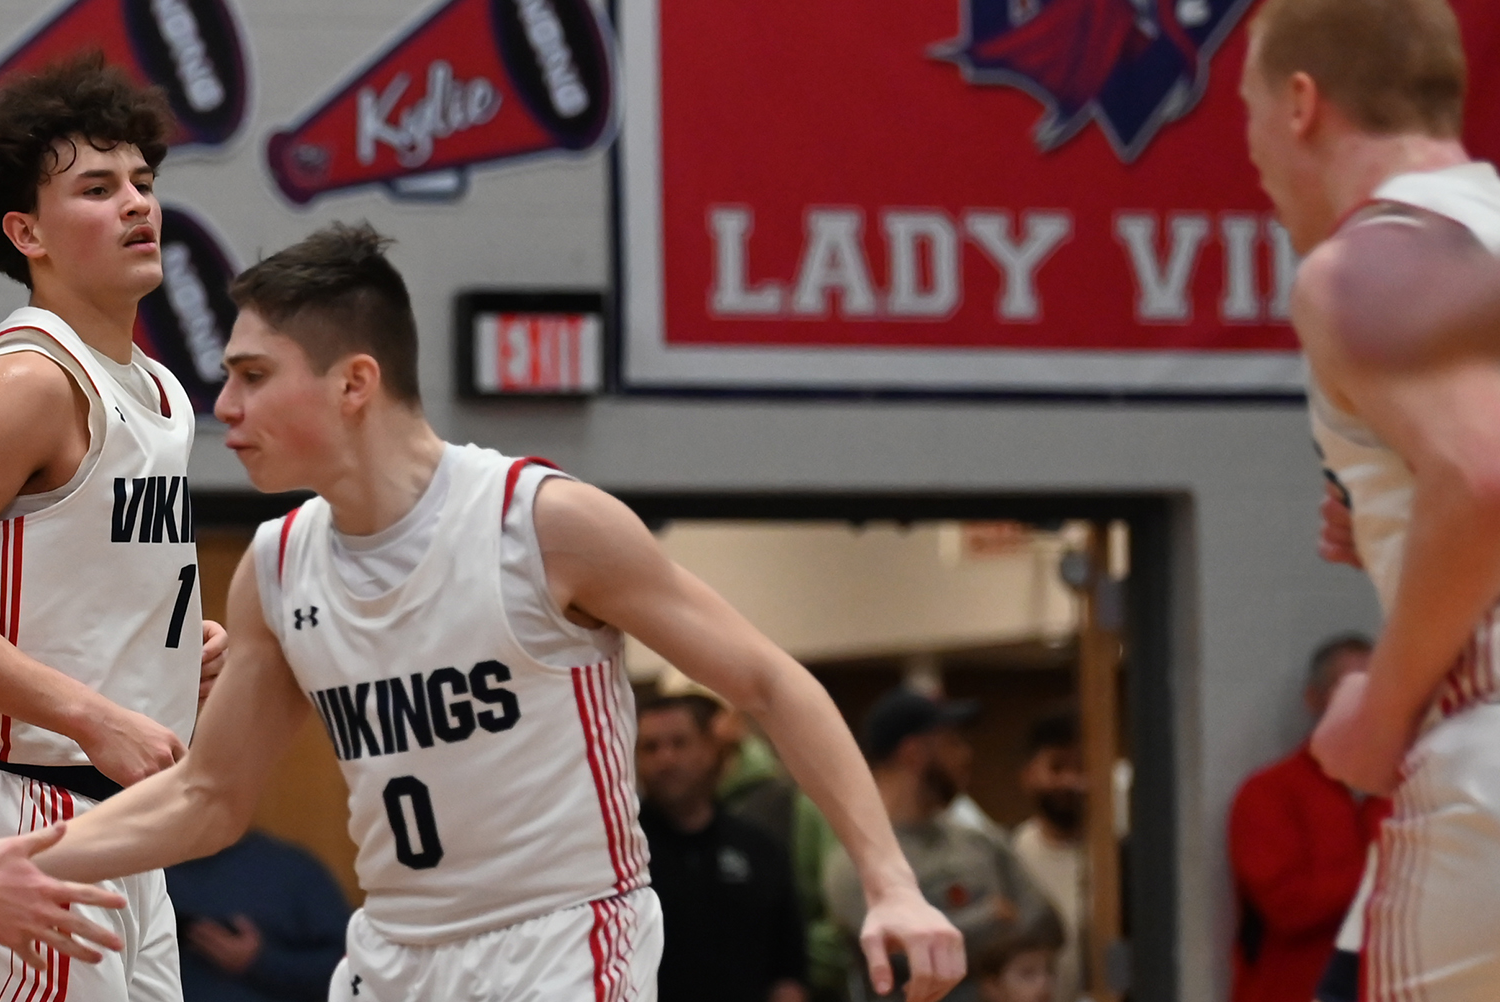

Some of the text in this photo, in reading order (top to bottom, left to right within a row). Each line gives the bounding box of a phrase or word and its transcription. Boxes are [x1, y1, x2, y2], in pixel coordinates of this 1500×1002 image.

[357, 63, 499, 164] Kylie
[708, 206, 1073, 321] LADY
[497, 314, 584, 391] EXIT
[111, 476, 195, 543] VIKI
[165, 564, 196, 649] 1
[383, 775, 444, 870] 0
